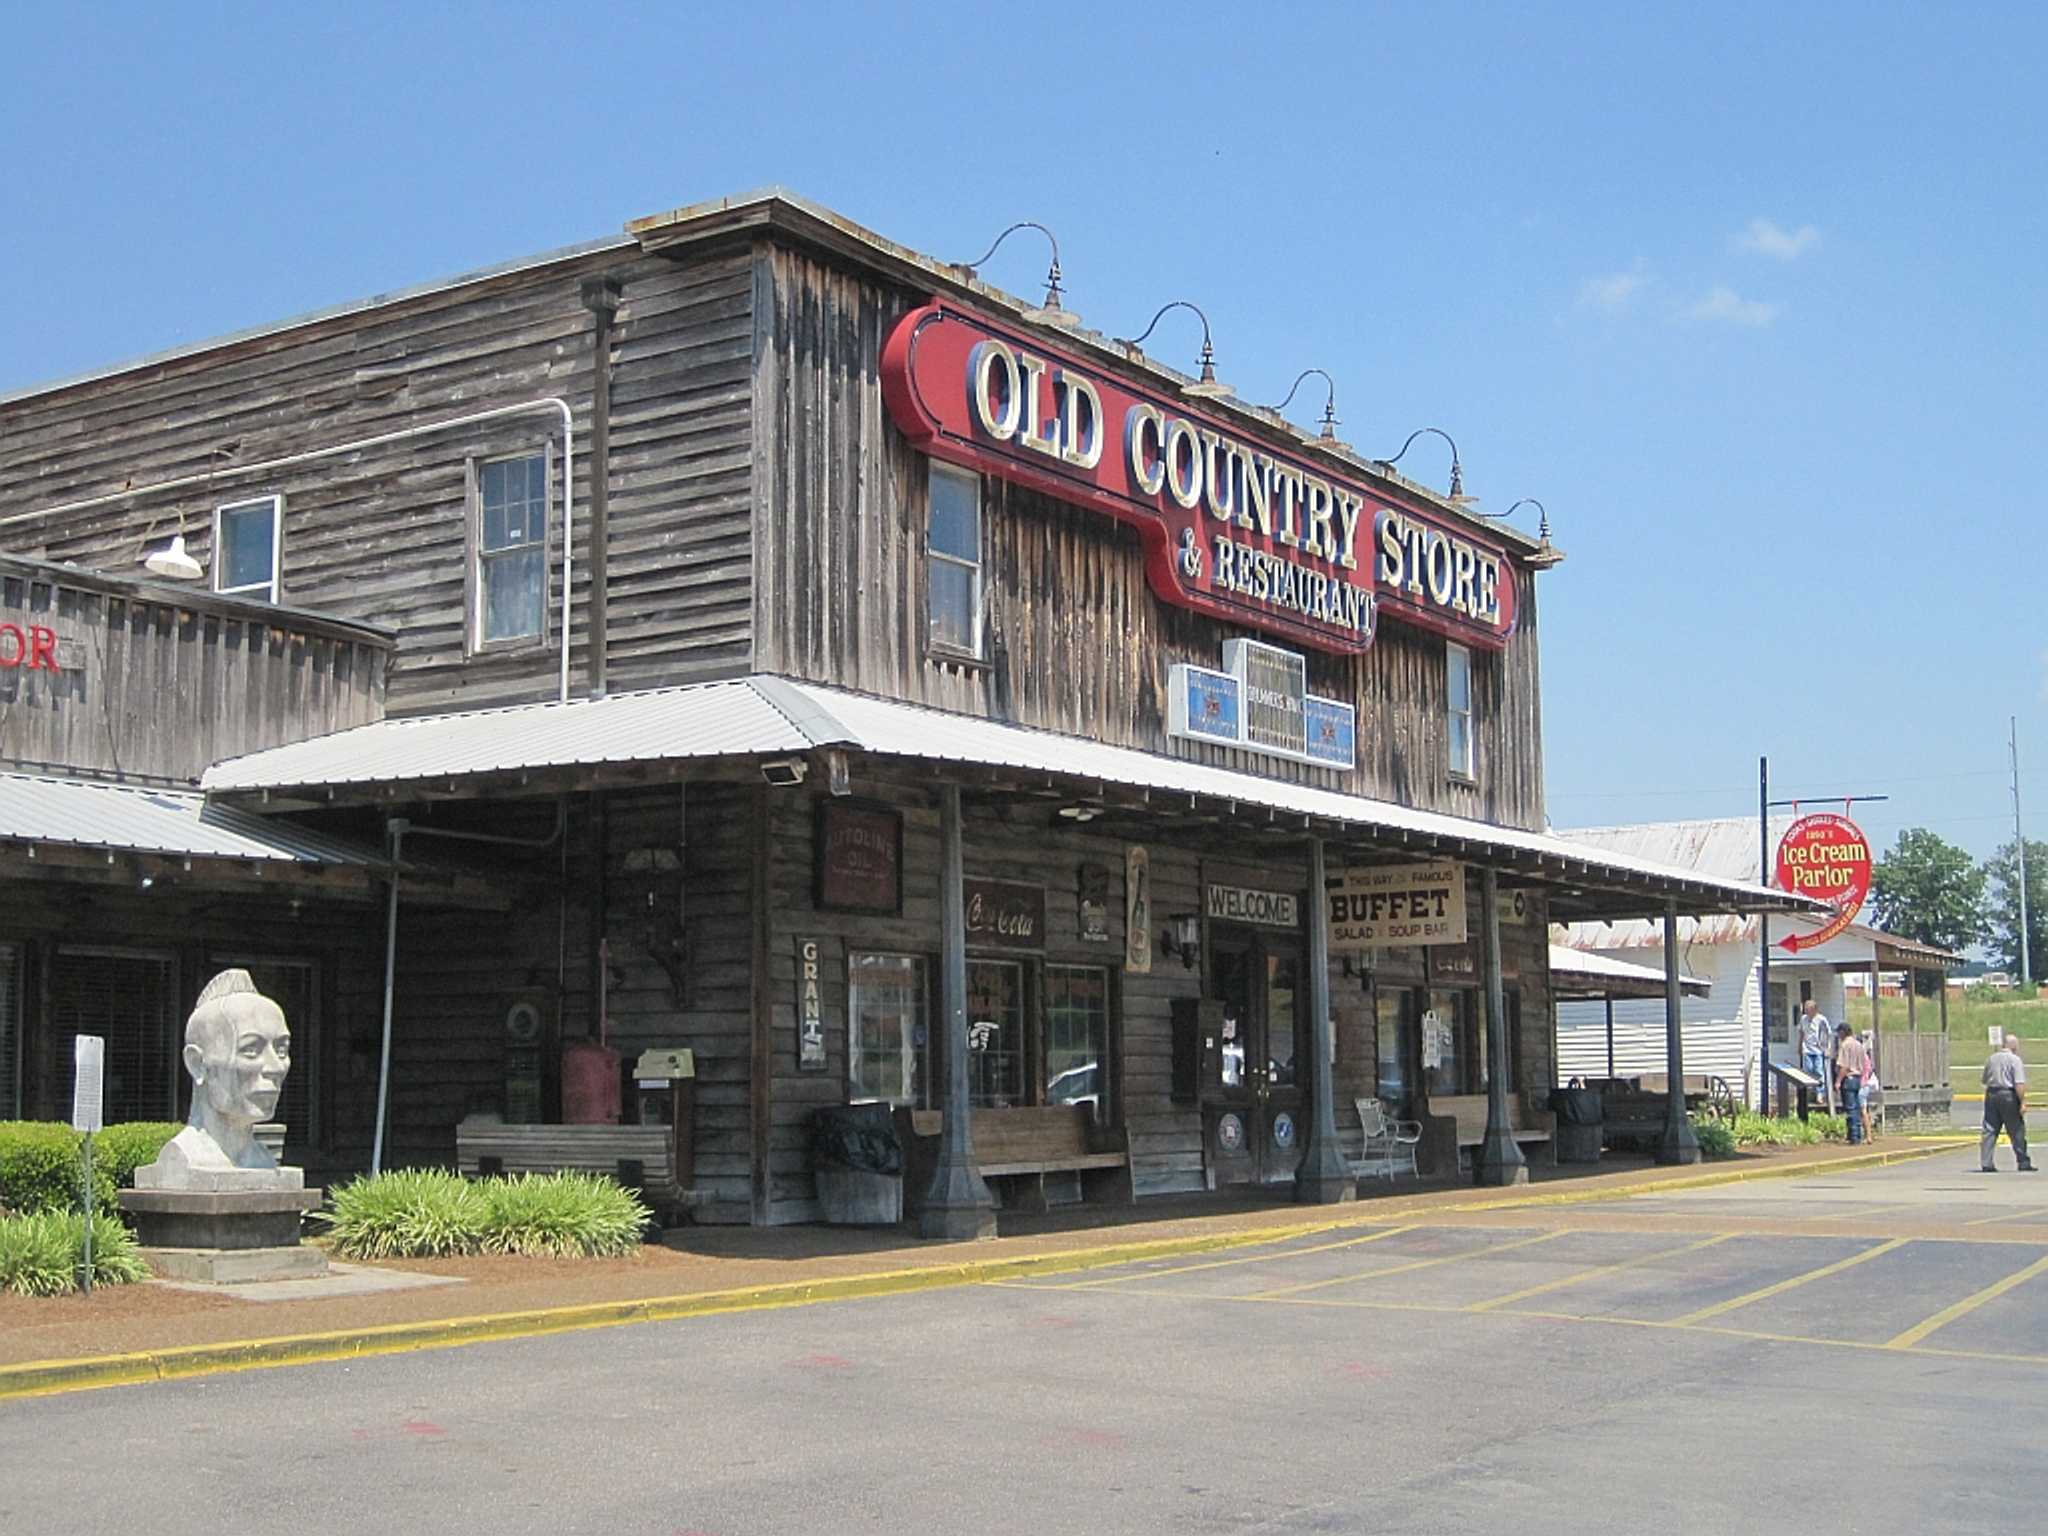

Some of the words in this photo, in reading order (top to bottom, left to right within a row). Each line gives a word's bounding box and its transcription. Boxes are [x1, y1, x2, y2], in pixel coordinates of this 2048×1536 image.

[969, 340, 1103, 470] OLD
[1127, 403, 1362, 571] COUNTRY
[1376, 509, 1500, 625] STORE
[1180, 527, 1202, 579] &
[1213, 534, 1375, 634] RESTAURANT
[1783, 844, 1807, 865] Ice
[1809, 842, 1866, 864] Cream
[1412, 870, 1454, 884] FAMOUS
[1792, 864, 1854, 887] Parlor
[1208, 886, 1290, 922] WELCOME
[1330, 888, 1449, 924] BUFFET
[1334, 926, 1374, 941] SALAD
[1388, 923, 1422, 938] SOUP
[1424, 922, 1449, 936] BAR
